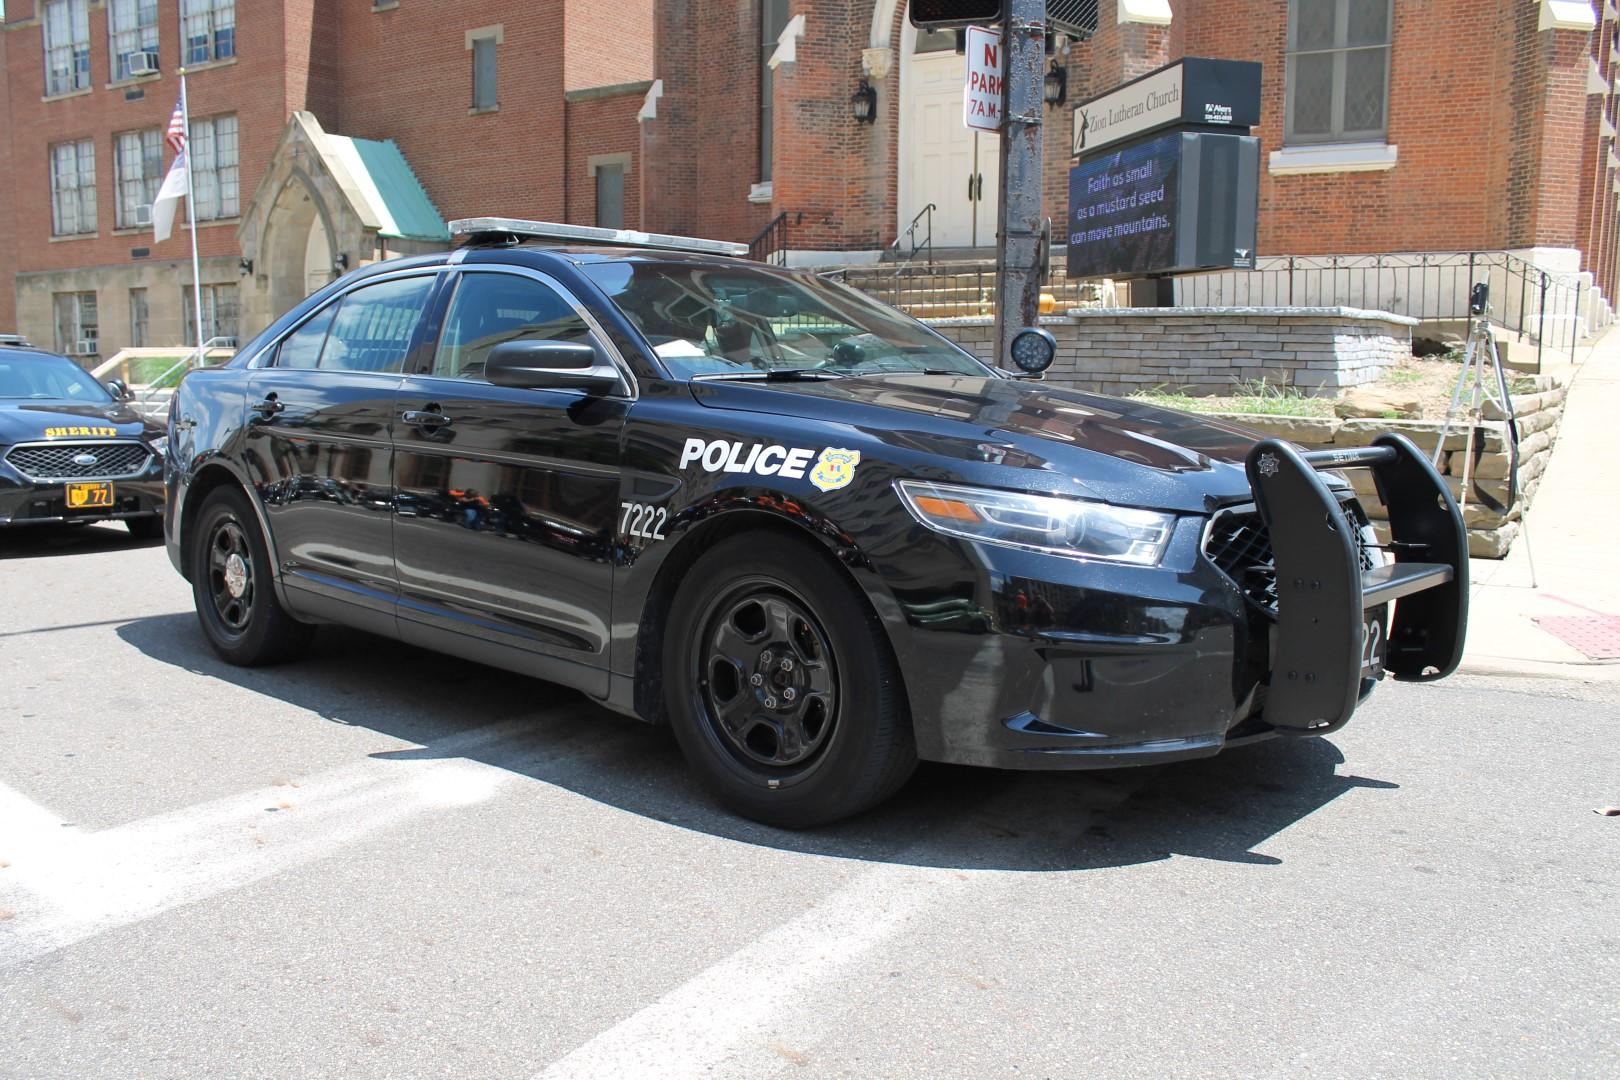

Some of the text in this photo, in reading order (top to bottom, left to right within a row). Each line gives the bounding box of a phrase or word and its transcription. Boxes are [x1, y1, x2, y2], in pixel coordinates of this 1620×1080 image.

[1089, 83, 1179, 133] Zion Lutheran Church
[1088, 160, 1153, 194] Faith as small
[1077, 184, 1164, 220] as a mustard seed
[1071, 212, 1170, 245] can move mountains.
[45, 427, 117, 437] SHERIFF
[679, 438, 815, 479] POLICE
[93, 489, 107, 504] 77
[621, 502, 667, 540] 7222
